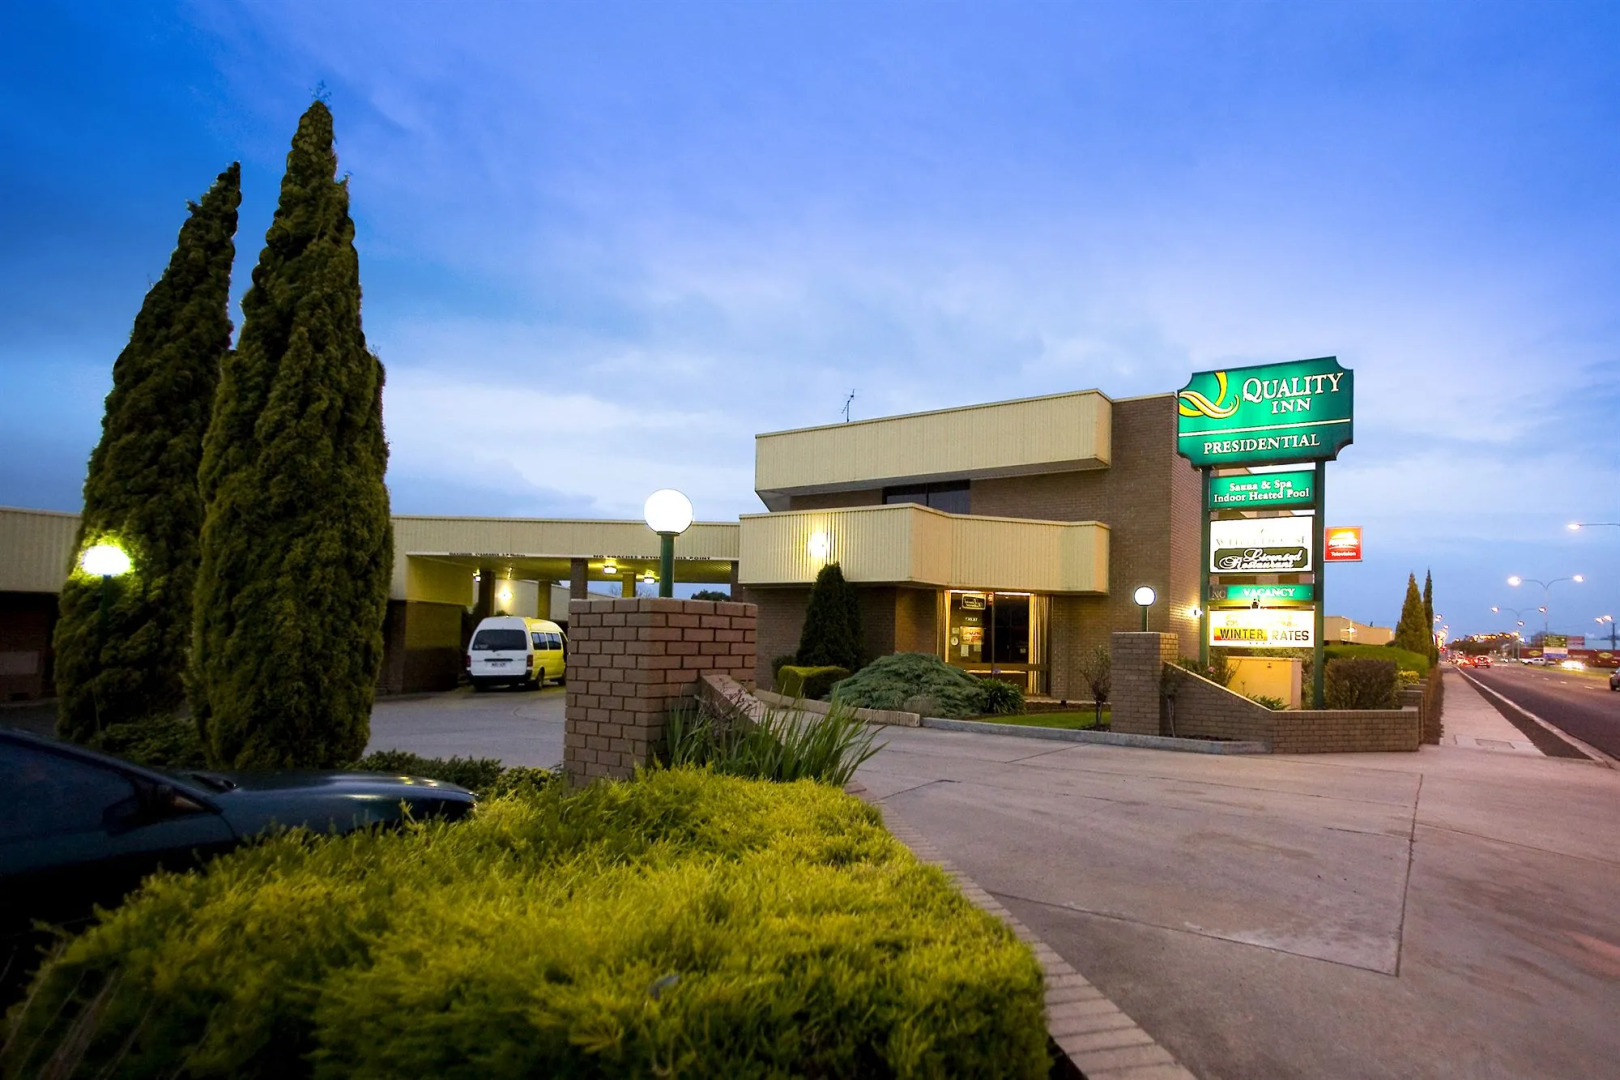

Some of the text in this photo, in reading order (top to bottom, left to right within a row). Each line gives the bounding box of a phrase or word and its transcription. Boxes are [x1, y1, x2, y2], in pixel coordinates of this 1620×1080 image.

[1242, 372, 1344, 403] QUALITY
[1271, 397, 1311, 414] INN
[1203, 433, 1320, 454] PRESIDENTIAL
[1229, 479, 1292, 491] Sauna & Spa
[1213, 487, 1310, 503] Indoor Heated Pool
[1243, 588, 1296, 597] VACANCY
[1219, 628, 1310, 641] WINTER RATES
